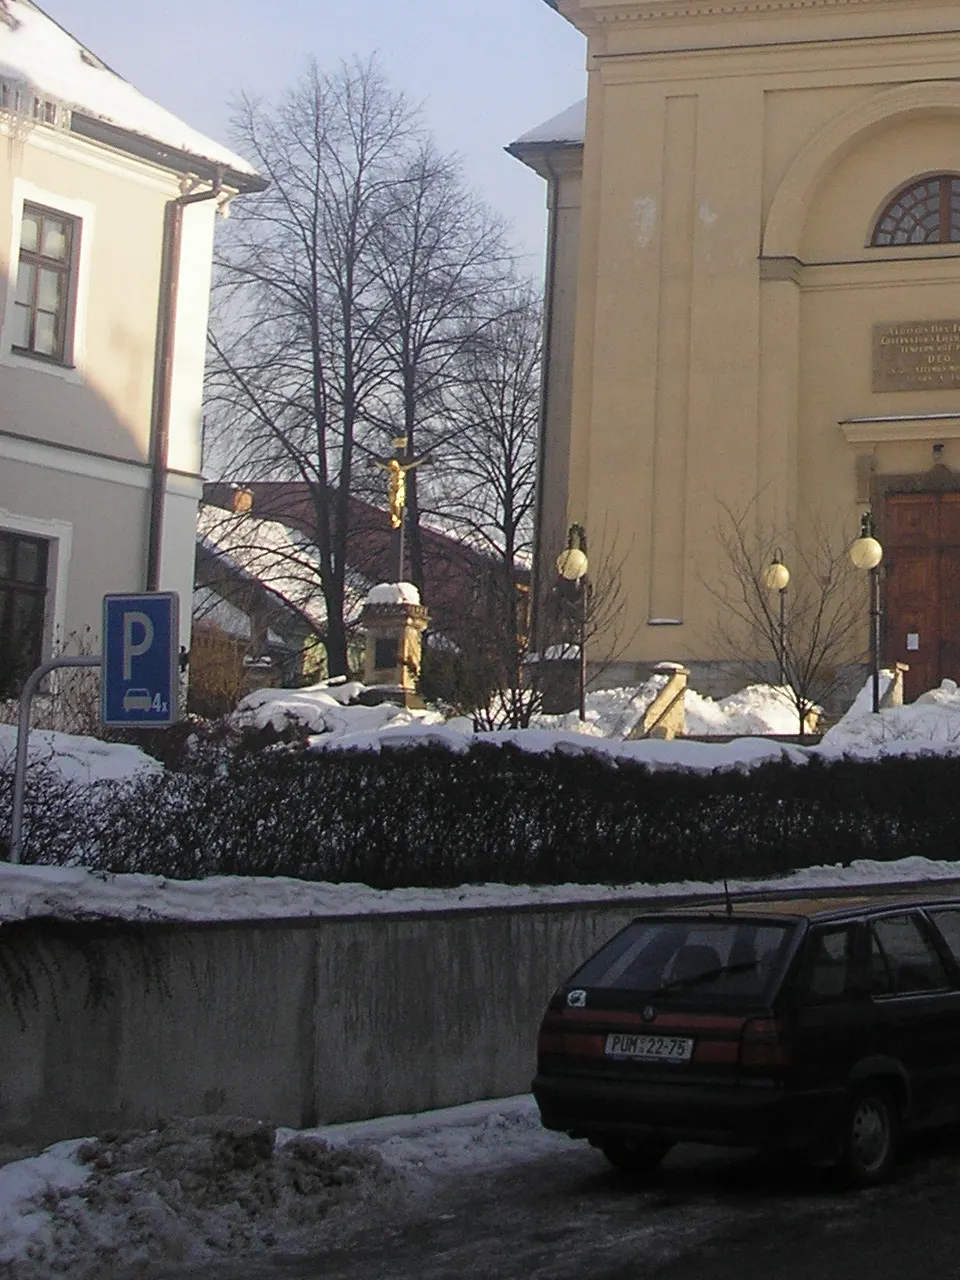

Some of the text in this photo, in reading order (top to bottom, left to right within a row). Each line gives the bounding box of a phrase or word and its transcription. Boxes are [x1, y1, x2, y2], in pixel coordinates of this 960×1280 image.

[123, 611, 154, 681] P
[152, 692, 168, 713] 4x
[646, 1037, 686, 1056] 22-75
